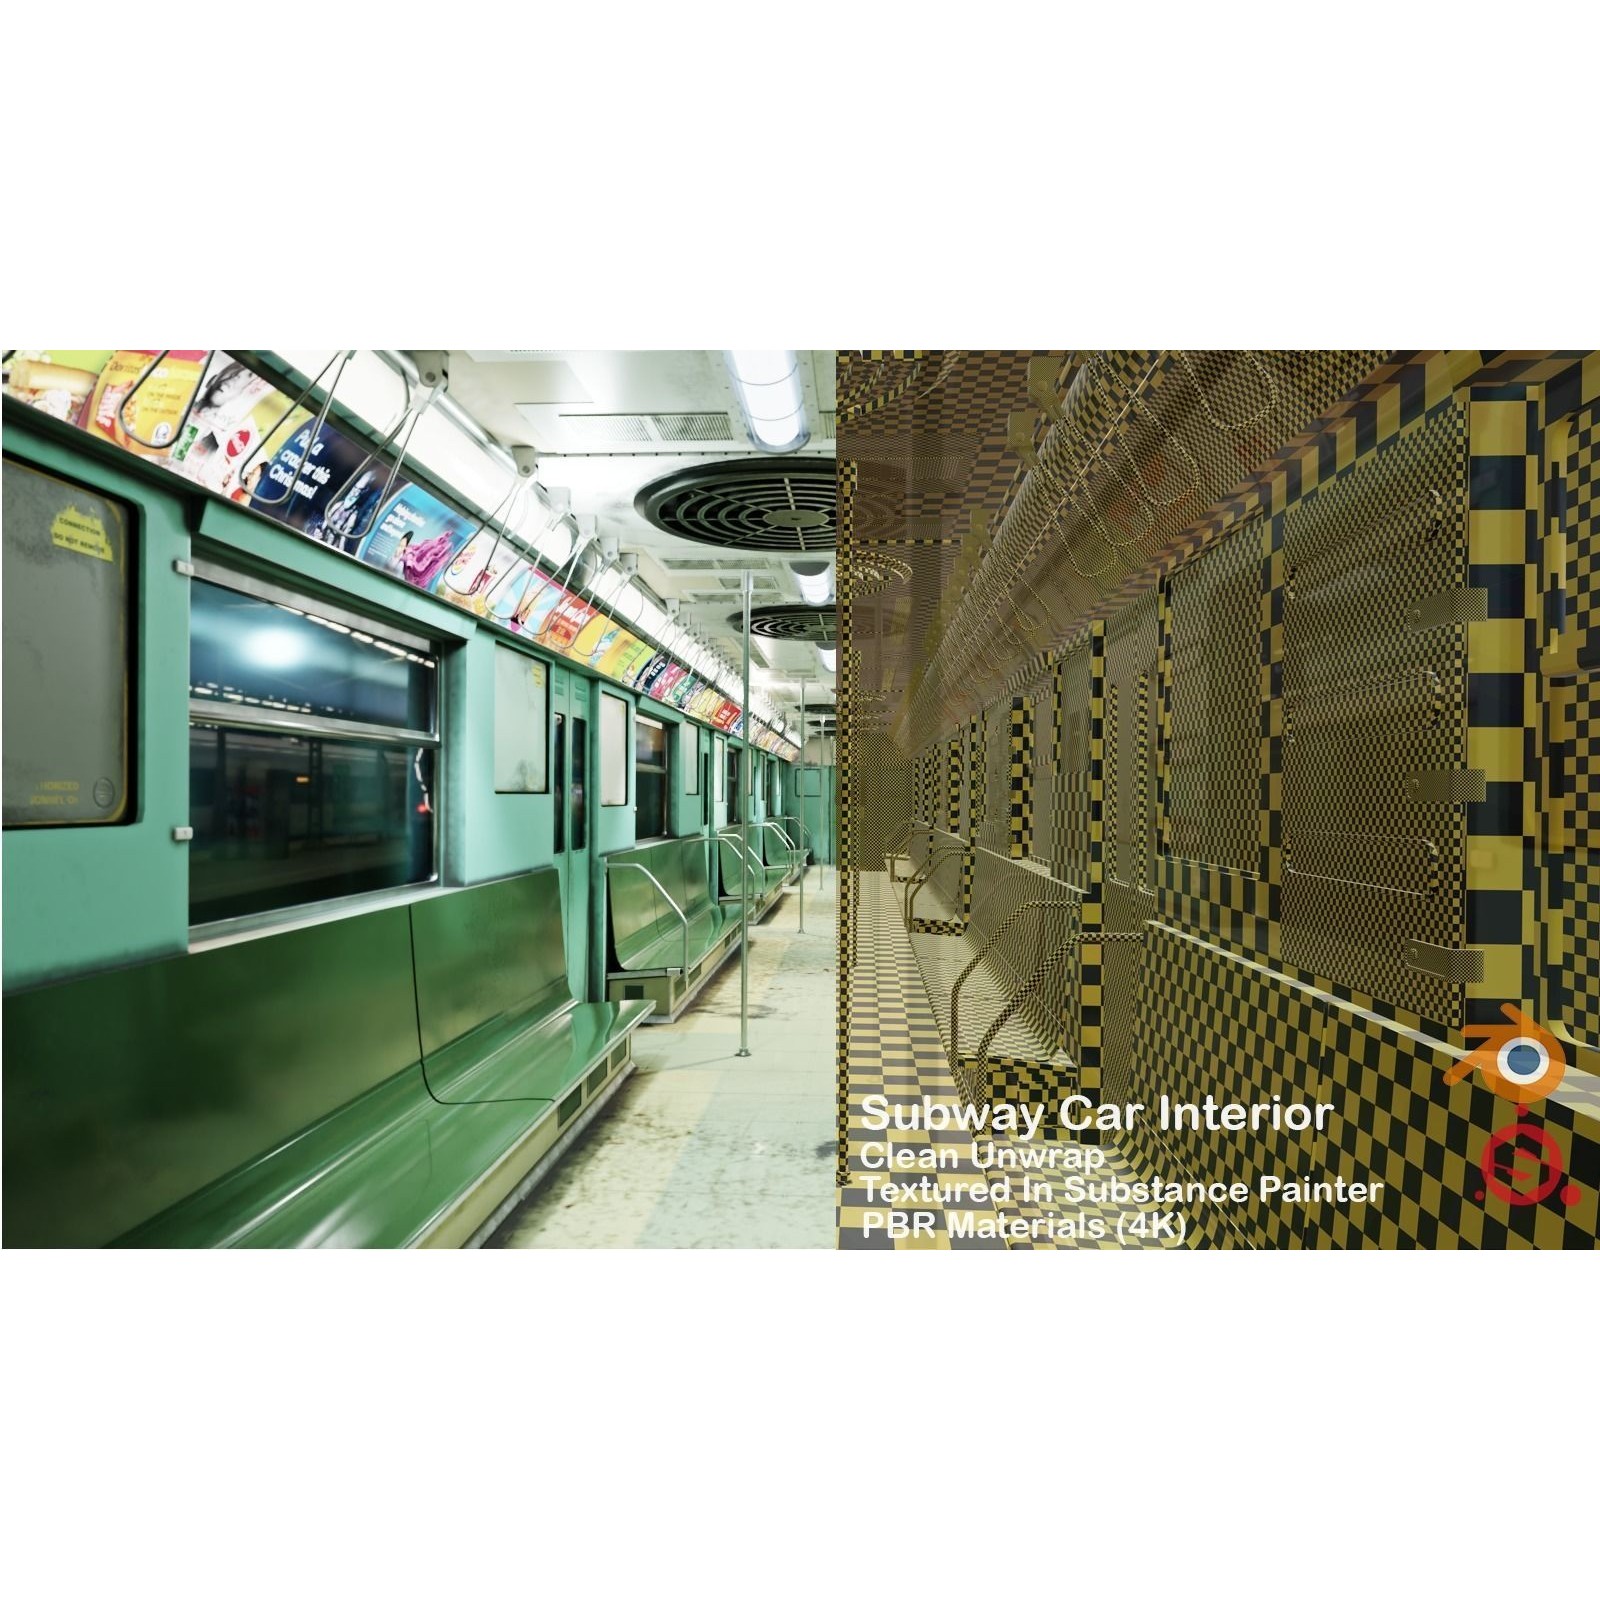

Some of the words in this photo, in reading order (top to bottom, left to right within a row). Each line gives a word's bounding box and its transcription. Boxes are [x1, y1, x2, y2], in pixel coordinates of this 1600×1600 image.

[311, 443, 325, 456] a
[281, 449, 316, 475] cracer
[311, 466, 331, 485] this
[269, 464, 319, 500] Chrismas!
[58, 517, 101, 536] CONNECTION
